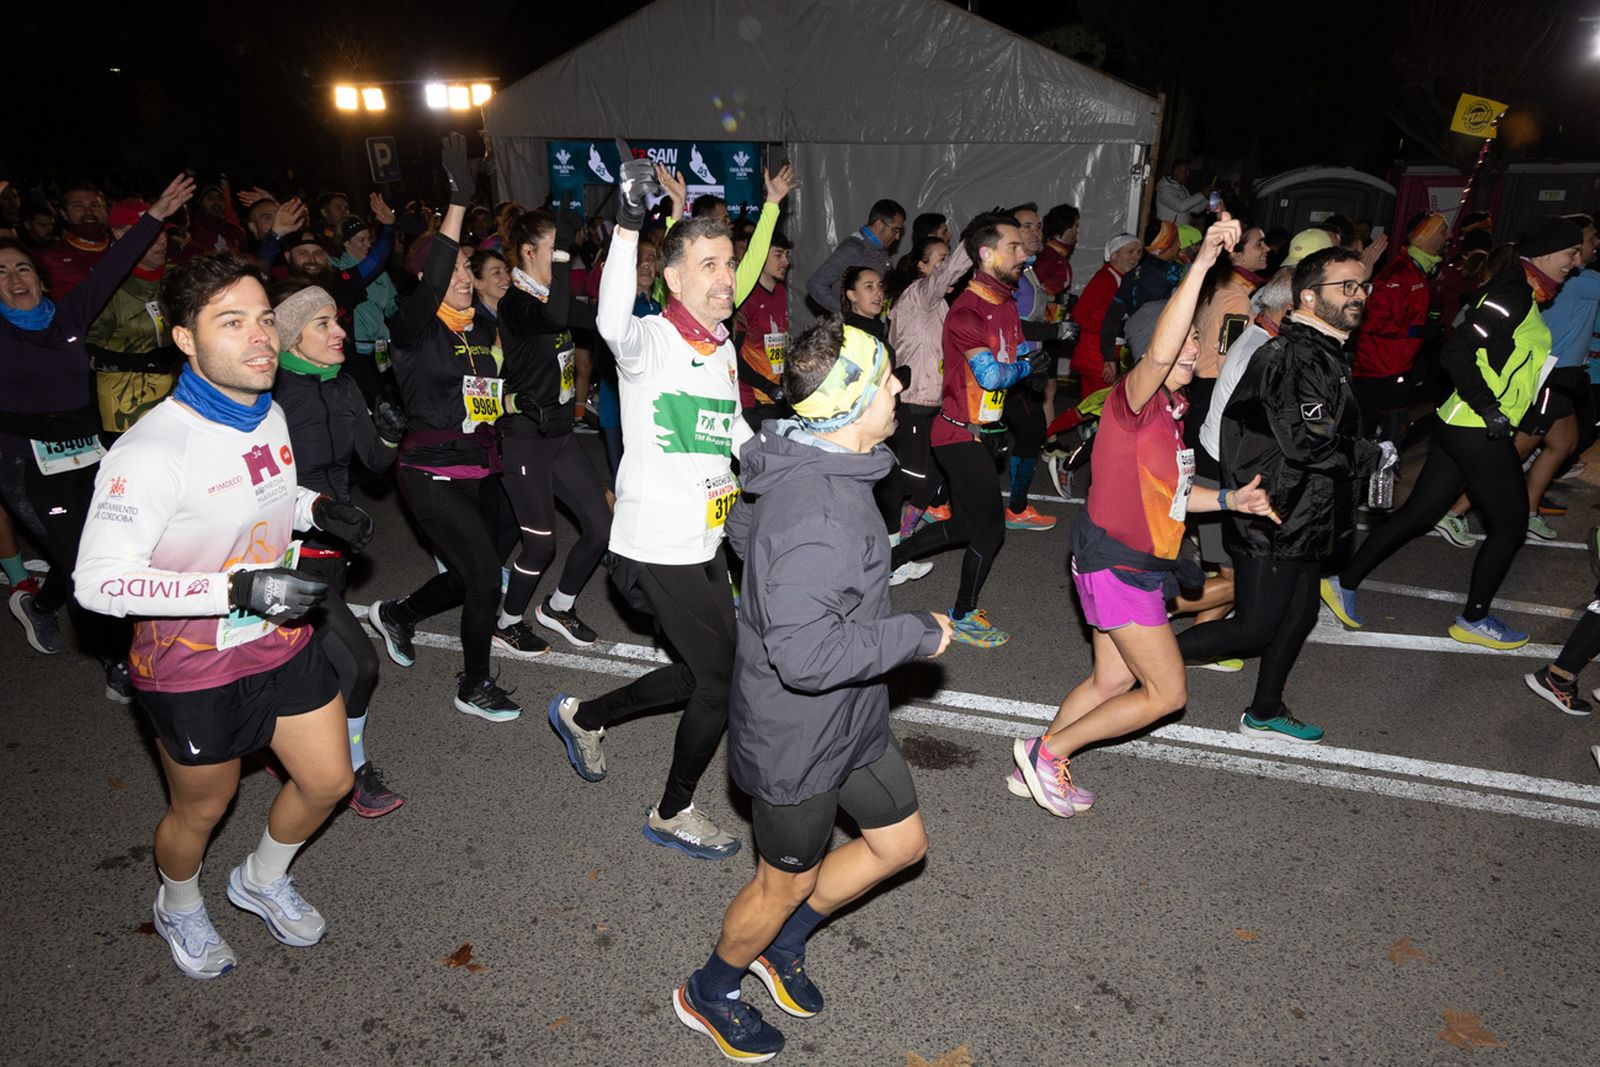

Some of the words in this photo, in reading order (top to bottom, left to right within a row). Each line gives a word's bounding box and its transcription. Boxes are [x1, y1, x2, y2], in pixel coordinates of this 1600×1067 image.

[374, 143, 392, 178] P
[648, 148, 678, 163] SAN
[472, 397, 498, 416] 9984
[674, 828, 702, 846] HOKA
